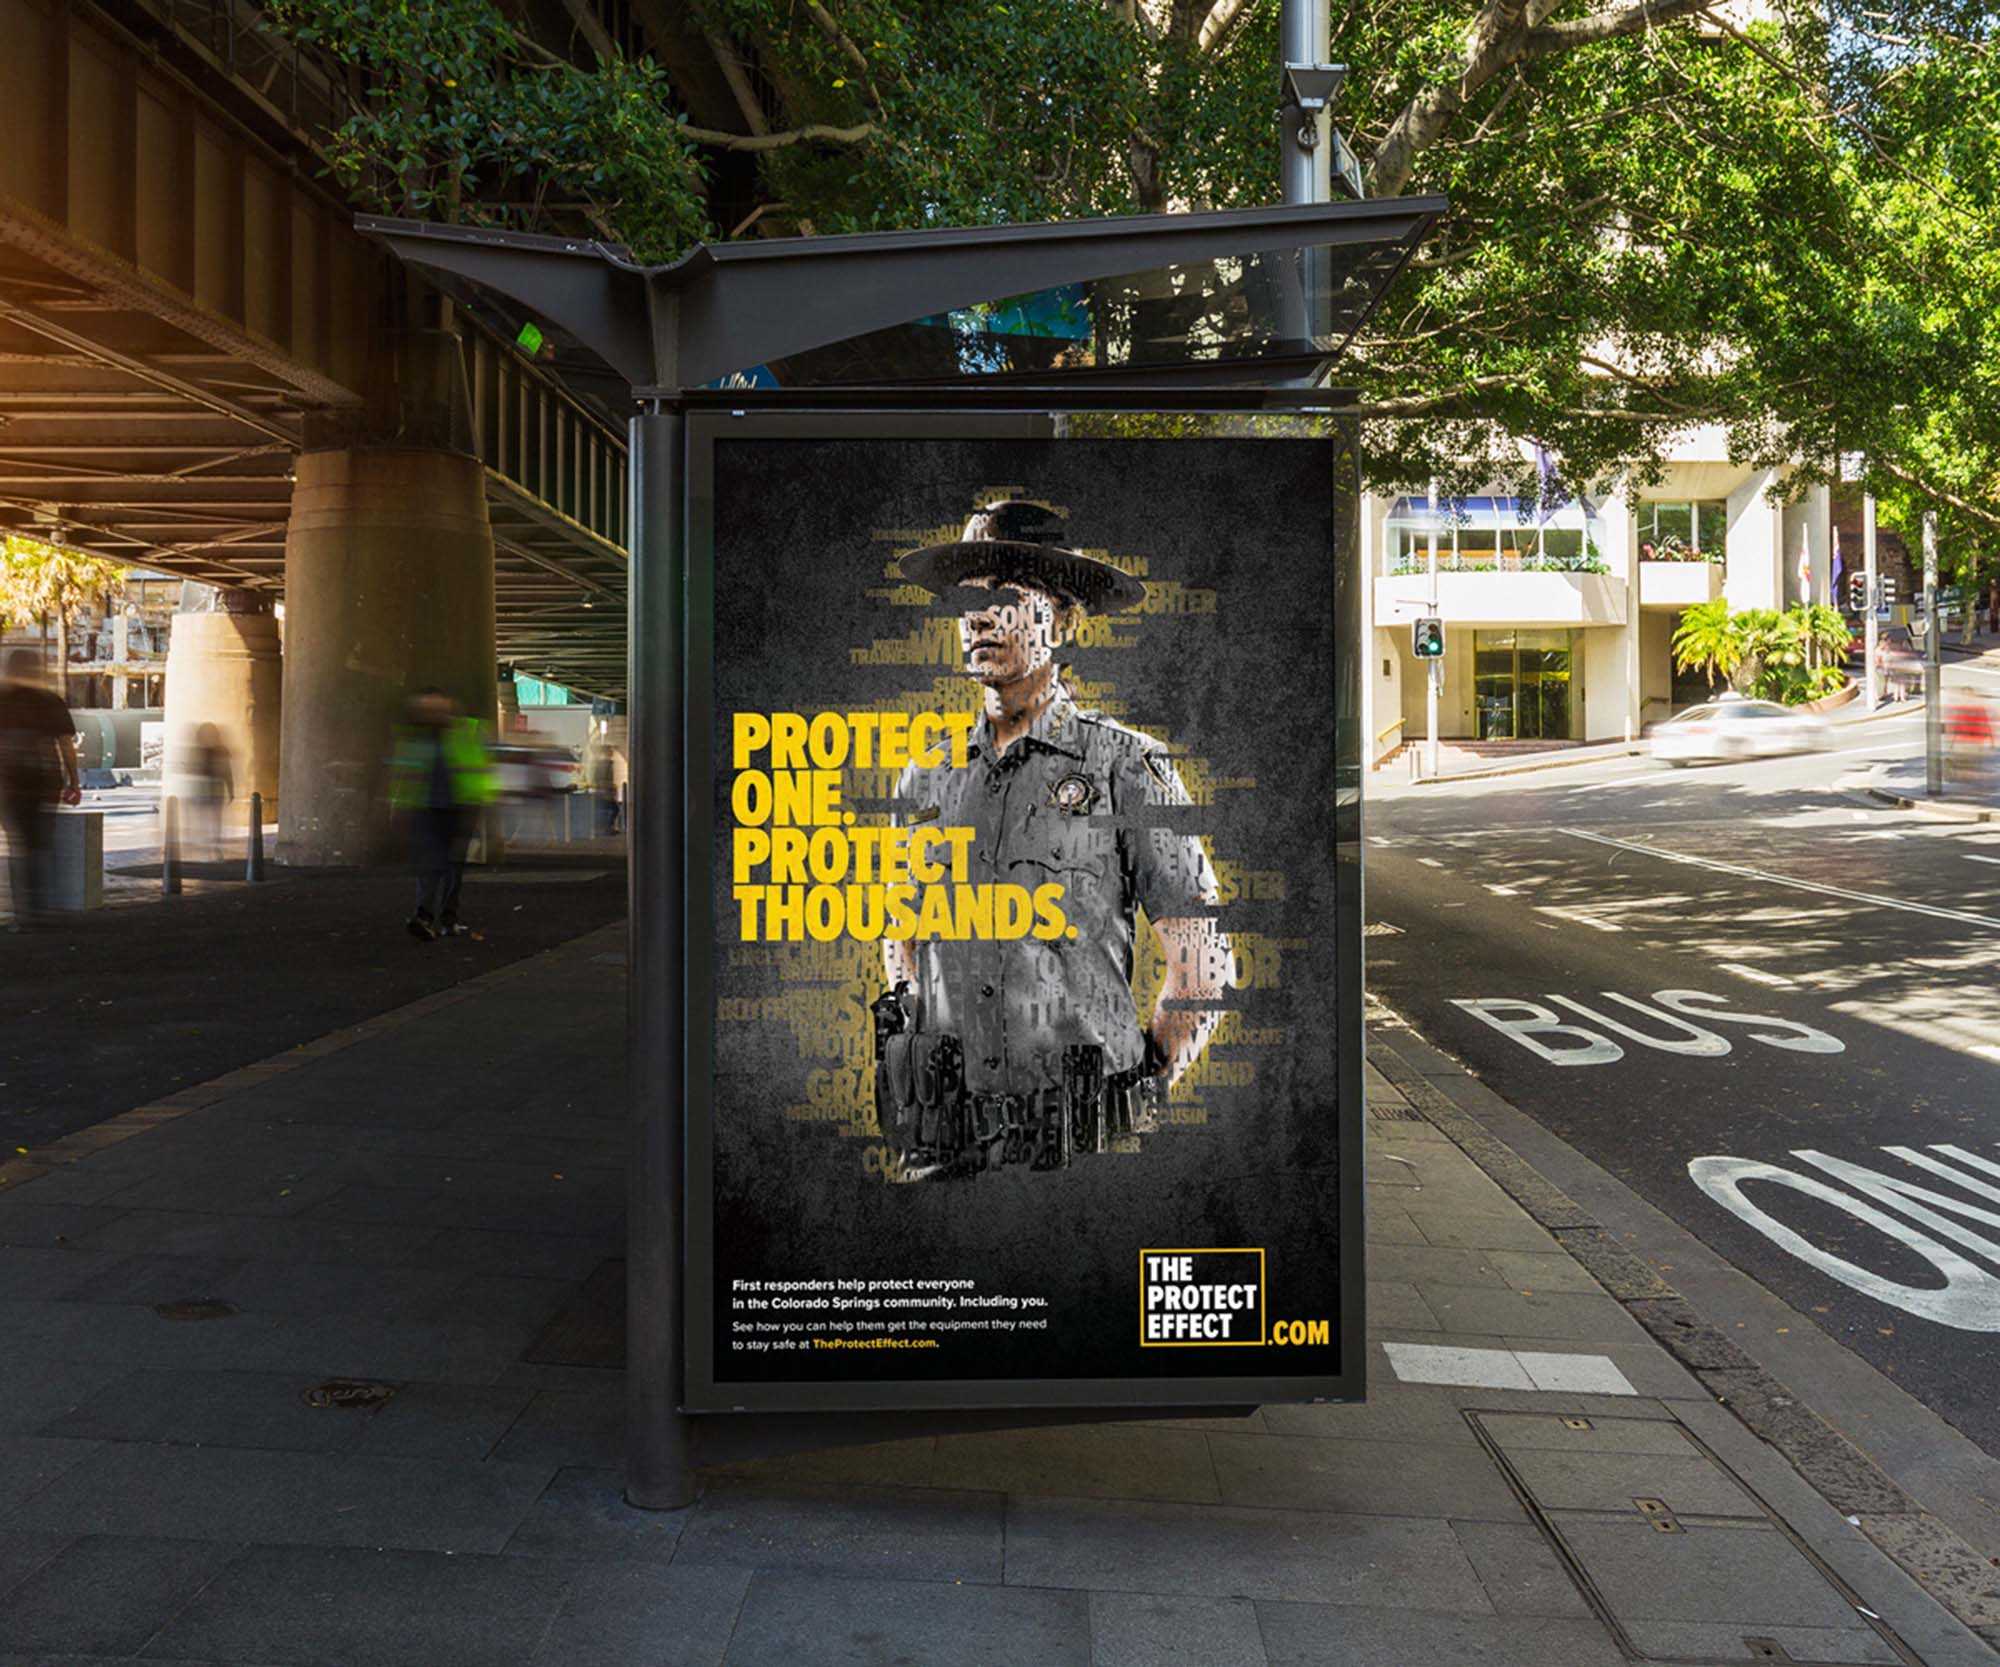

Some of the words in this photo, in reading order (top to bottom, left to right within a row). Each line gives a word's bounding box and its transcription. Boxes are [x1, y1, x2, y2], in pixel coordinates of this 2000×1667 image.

[733, 711, 975, 769] PROTECT
[732, 769, 856, 826] ONE.
[733, 826, 975, 884] PROTECT
[733, 883, 1078, 942] THOUSANDS.
[1162, 917, 1218, 936] PARENT
[1449, 989, 1846, 1066] BUS
[1146, 1256, 1193, 1282] THE
[732, 1279, 761, 1291] First
[764, 1279, 836, 1293] responders
[837, 1278, 866, 1293] help
[868, 1279, 914, 1293] protect
[916, 1279, 975, 1292] everyone
[1147, 1284, 1258, 1311] PROTECT
[732, 1297, 745, 1309] in
[747, 1297, 769, 1309] the
[771, 1297, 830, 1309] Colorado
[832, 1296, 881, 1311] Springs
[882, 1295, 957, 1310] community.
[959, 1295, 1018, 1310] Including
[1020, 1297, 1049, 1310] you.
[732, 1320, 754, 1332] See
[756, 1320, 781, 1332] how
[782, 1322, 804, 1334] you
[806, 1322, 827, 1331] can
[829, 1319, 854, 1333] help
[856, 1319, 885, 1331] them
[887, 1321, 906, 1333] get
[908, 1319, 927, 1330] the
[929, 1319, 989, 1333] equipment
[991, 1318, 1016, 1332] they
[1019, 1317, 1047, 1329] need
[1147, 1313, 1233, 1339] EFFECT
[1267, 1320, 1329, 1346] .COM
[732, 1339, 744, 1350] to
[746, 1339, 770, 1352] stay
[772, 1338, 796, 1350] safe
[798, 1339, 810, 1350] at
[812, 1337, 941, 1349] TheProtectEffect.com.
